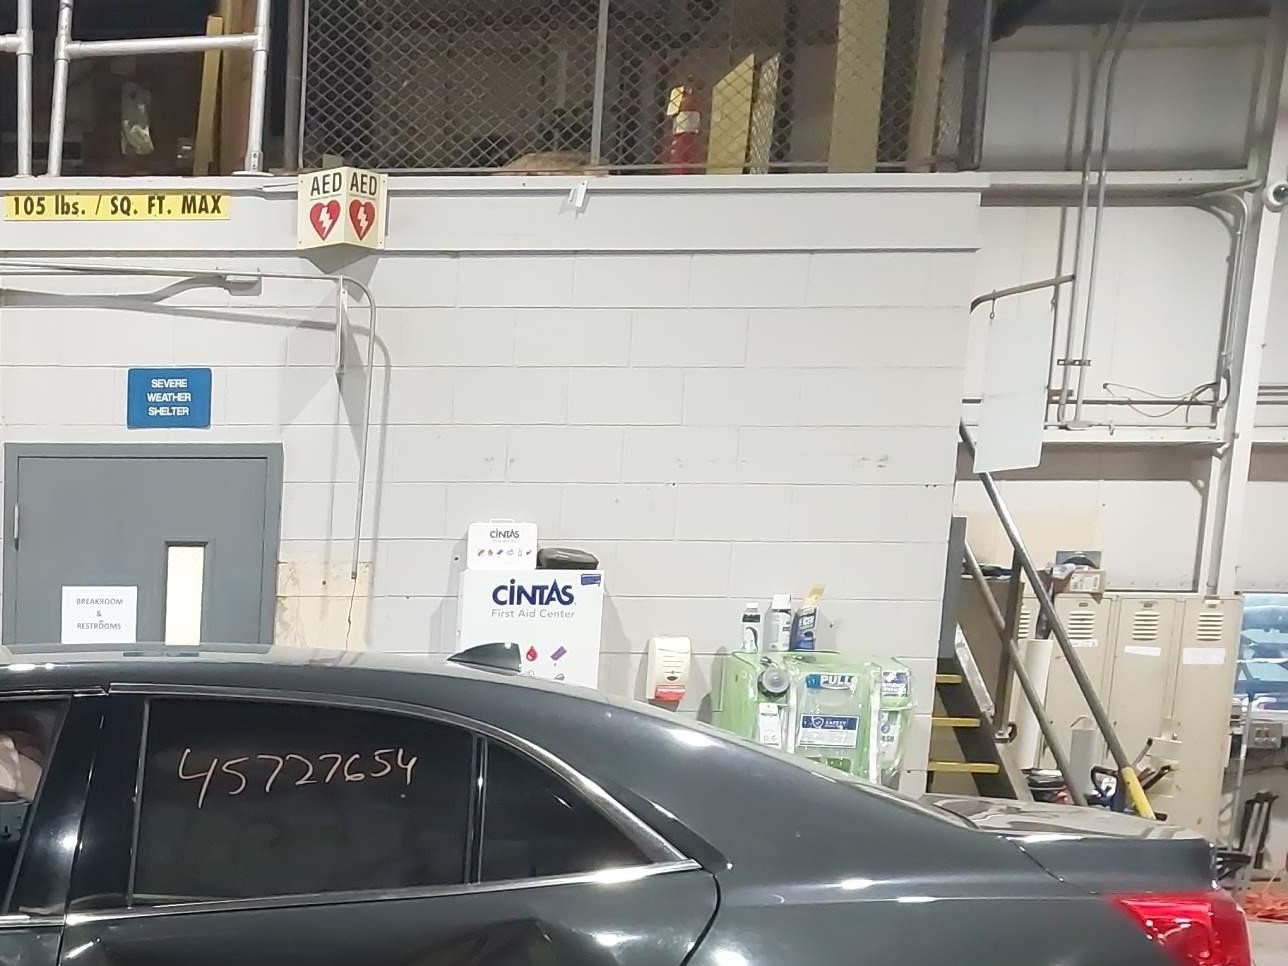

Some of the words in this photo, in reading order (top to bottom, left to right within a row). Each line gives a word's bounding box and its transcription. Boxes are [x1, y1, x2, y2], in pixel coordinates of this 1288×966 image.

[310, 172, 342, 196] AED
[350, 172, 377, 196] AED
[14, 196, 46, 215] 105
[55, 195, 86, 215] lbs.
[95, 195, 102, 215] /
[110, 196, 138, 216] SQ.
[147, 196, 172, 215] FT.
[181, 195, 222, 215] MAX
[151, 378, 188, 388] SEVERE
[146, 392, 191, 402] WEATHER
[148, 406, 190, 416] SHELTER
[76, 598, 123, 606] BREAKROOM
[491, 608, 514, 618] First
[518, 607, 536, 618] Aid
[539, 608, 575, 618] Center
[76, 622, 122, 630] RESTROOMS
[178, 748, 418, 809] 45727654
